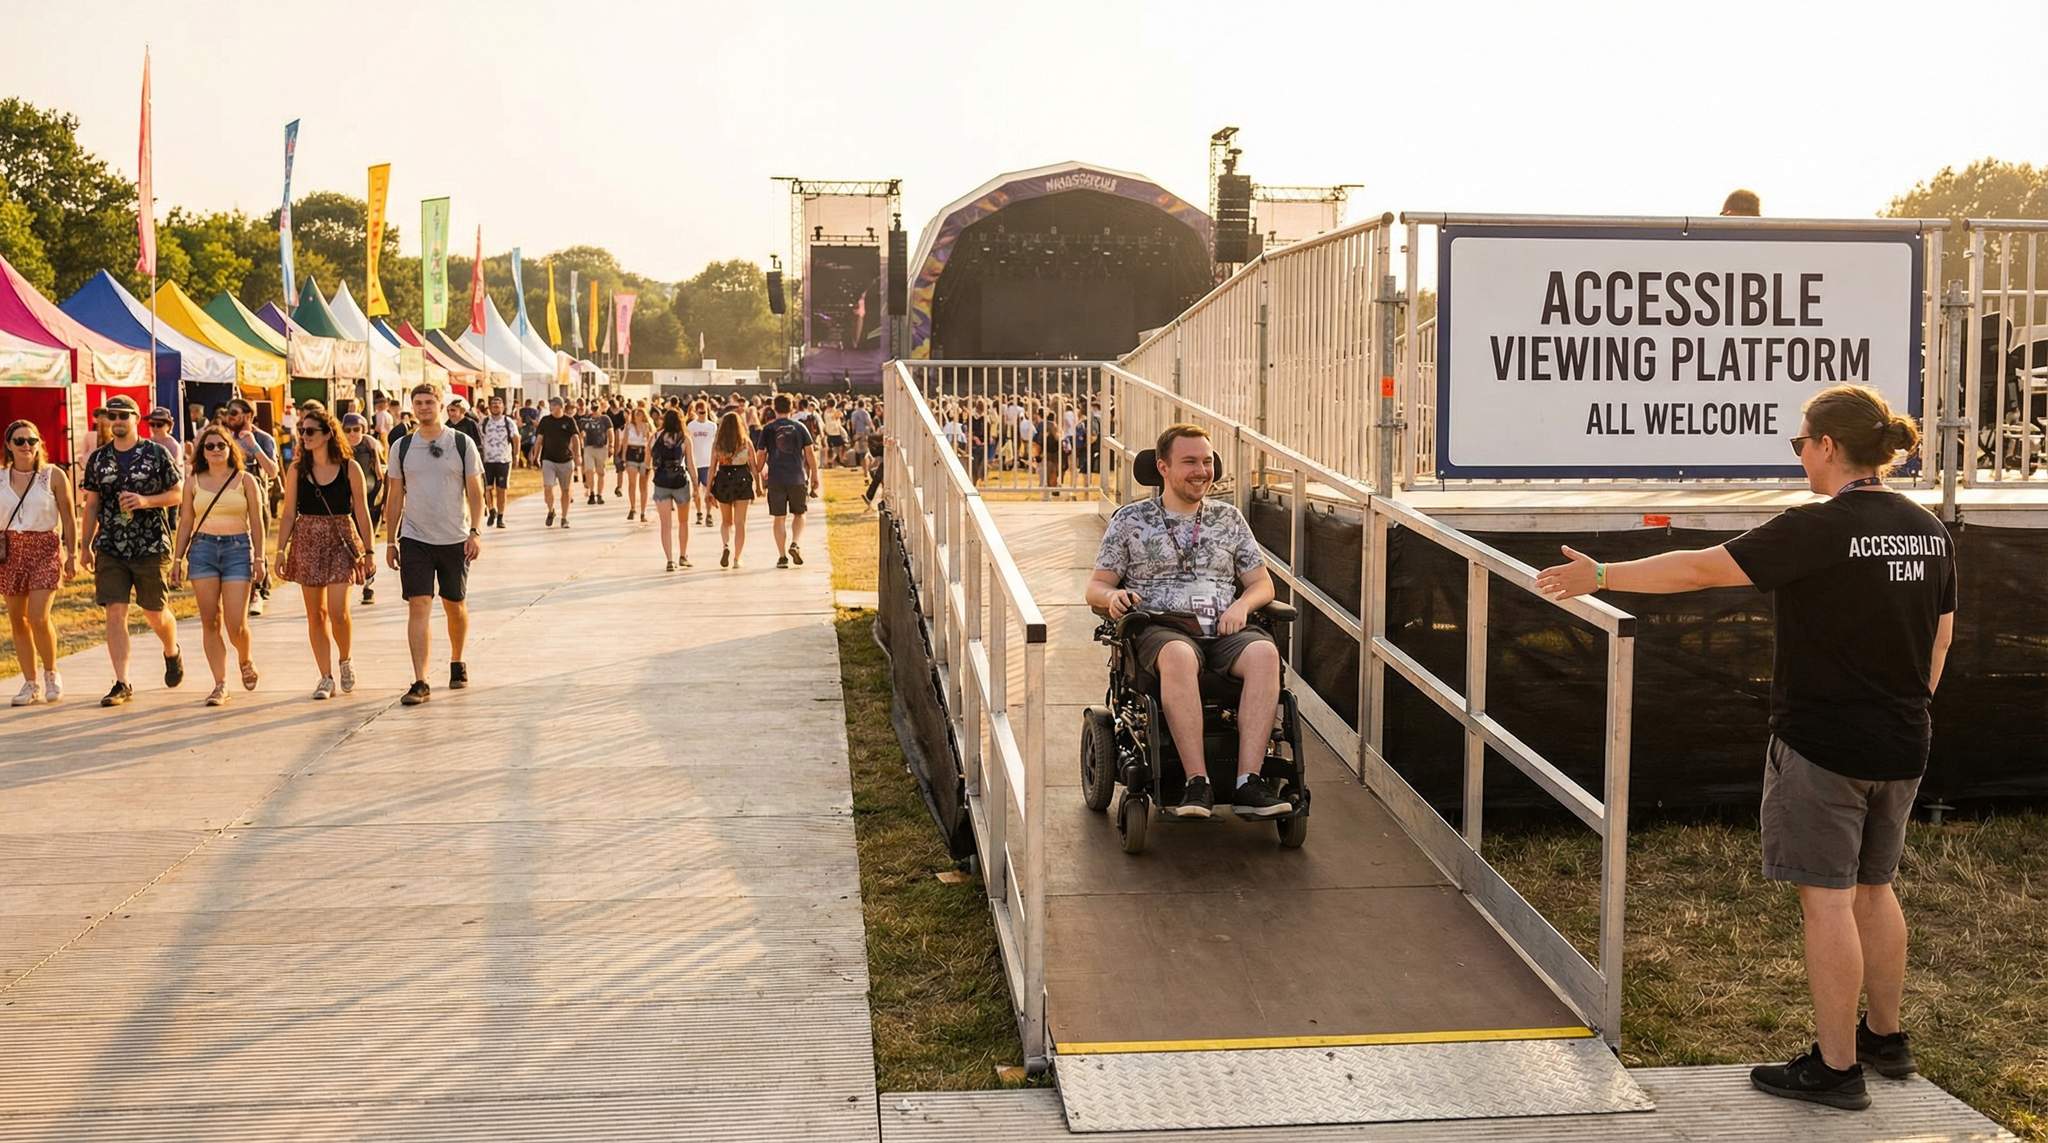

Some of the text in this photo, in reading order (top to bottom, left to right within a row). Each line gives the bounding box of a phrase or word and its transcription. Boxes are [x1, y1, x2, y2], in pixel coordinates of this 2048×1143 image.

[1540, 270, 1824, 327] ACCESSIBLE
[1489, 335, 1870, 382] VIEWING PLATFORM
[1585, 402, 1779, 436] ALL WELCOME
[1848, 534, 1947, 558] ACCESSIBILITY
[1886, 560, 1925, 582] TEAM
